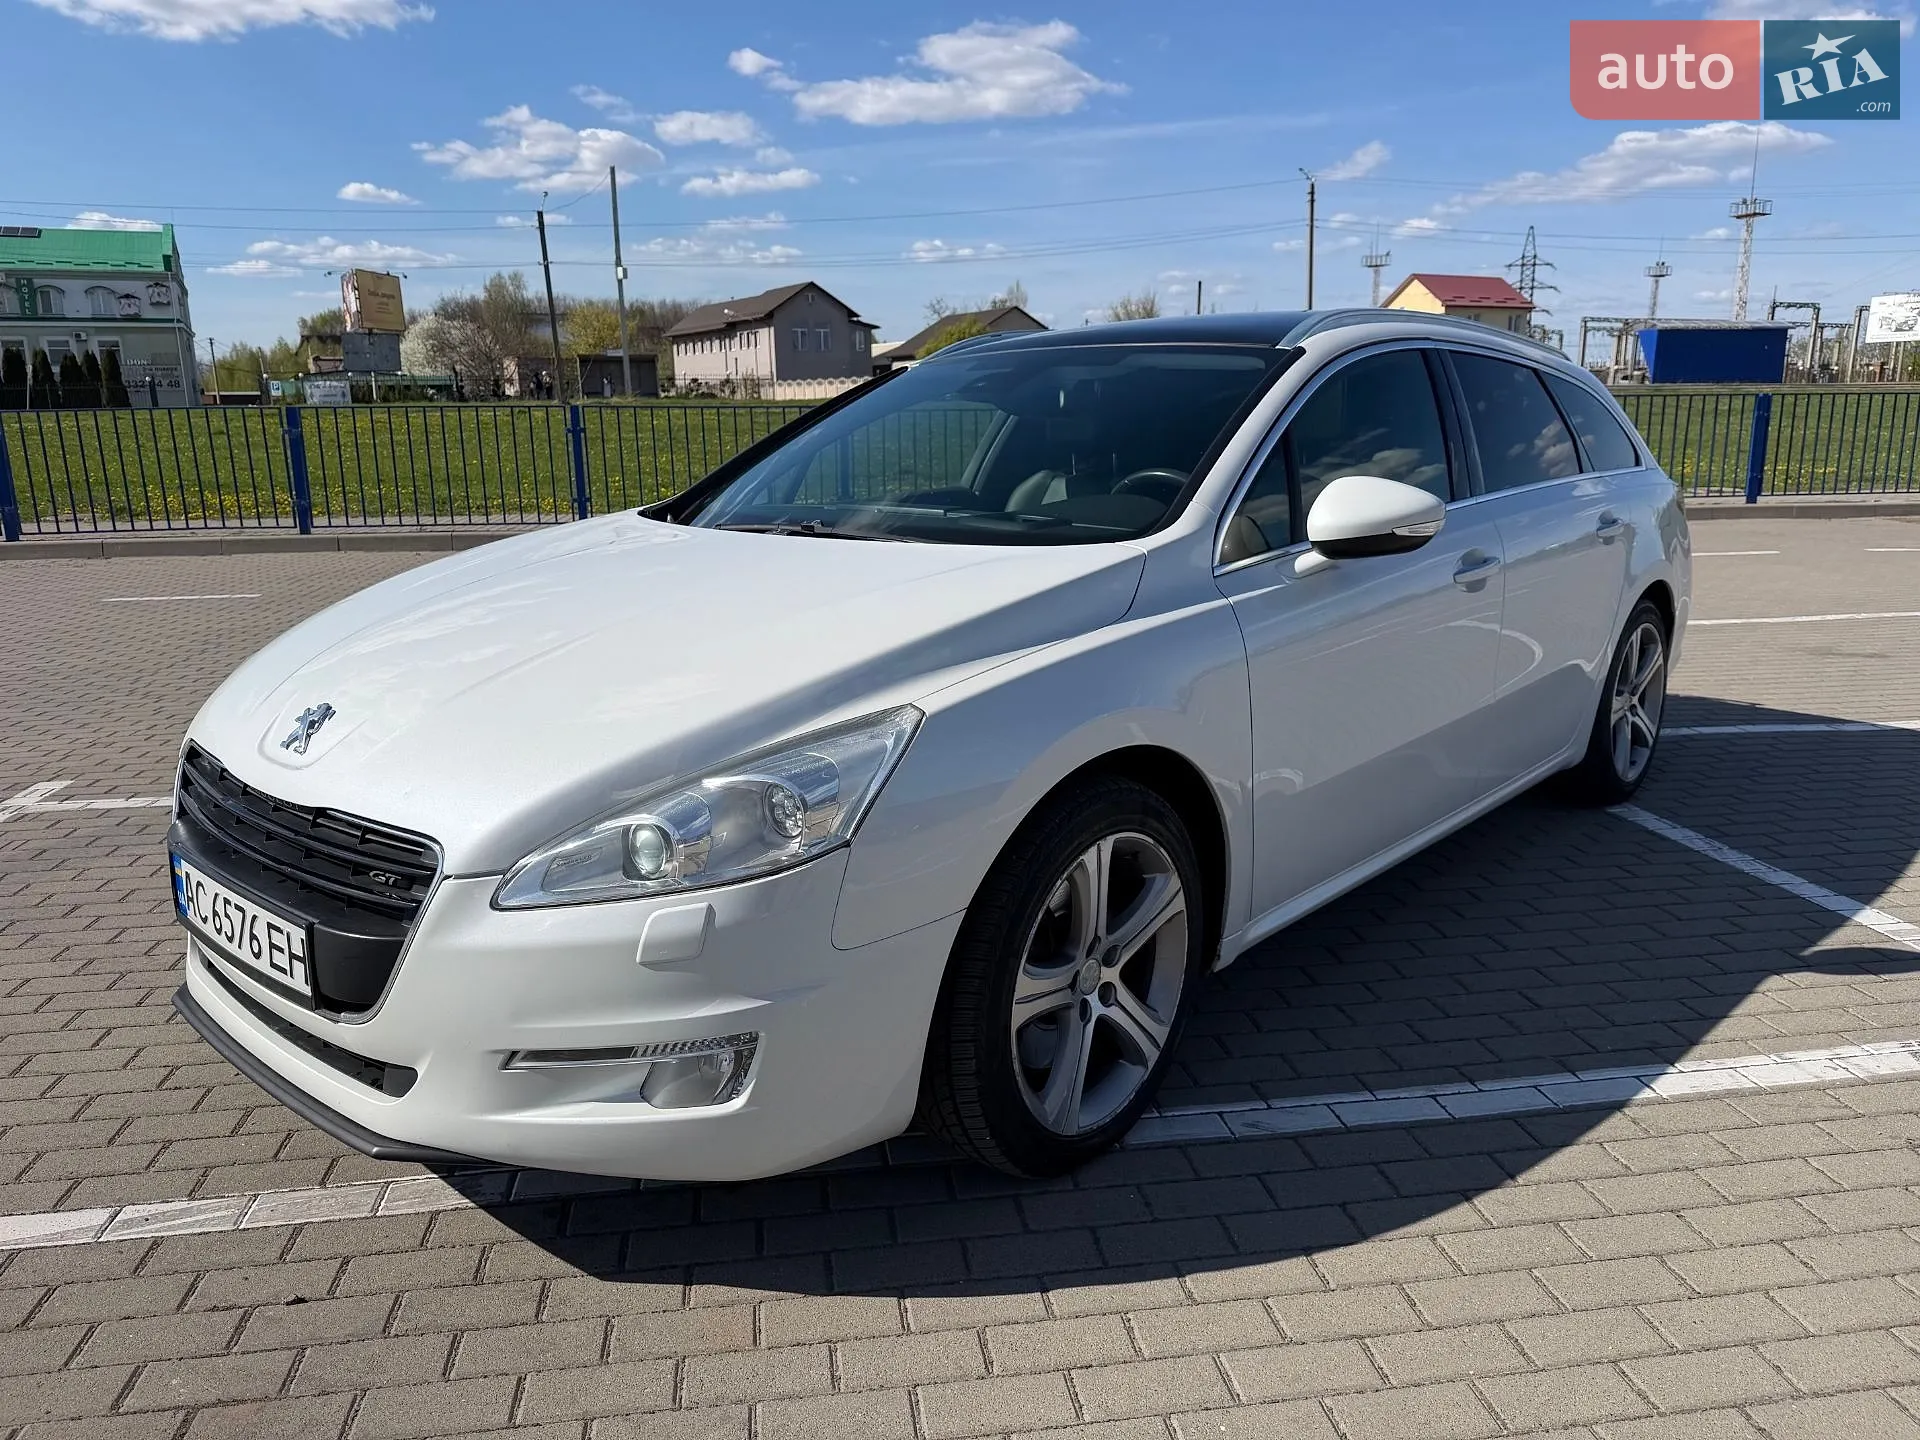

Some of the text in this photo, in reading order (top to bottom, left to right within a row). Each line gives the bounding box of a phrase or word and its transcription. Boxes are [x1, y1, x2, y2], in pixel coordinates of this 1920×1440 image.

[20, 279, 32, 315] HOTEL
[369, 870, 402, 886] GT
[177, 889, 187, 906] UA
[185, 870, 310, 987] AC 6576 EH
